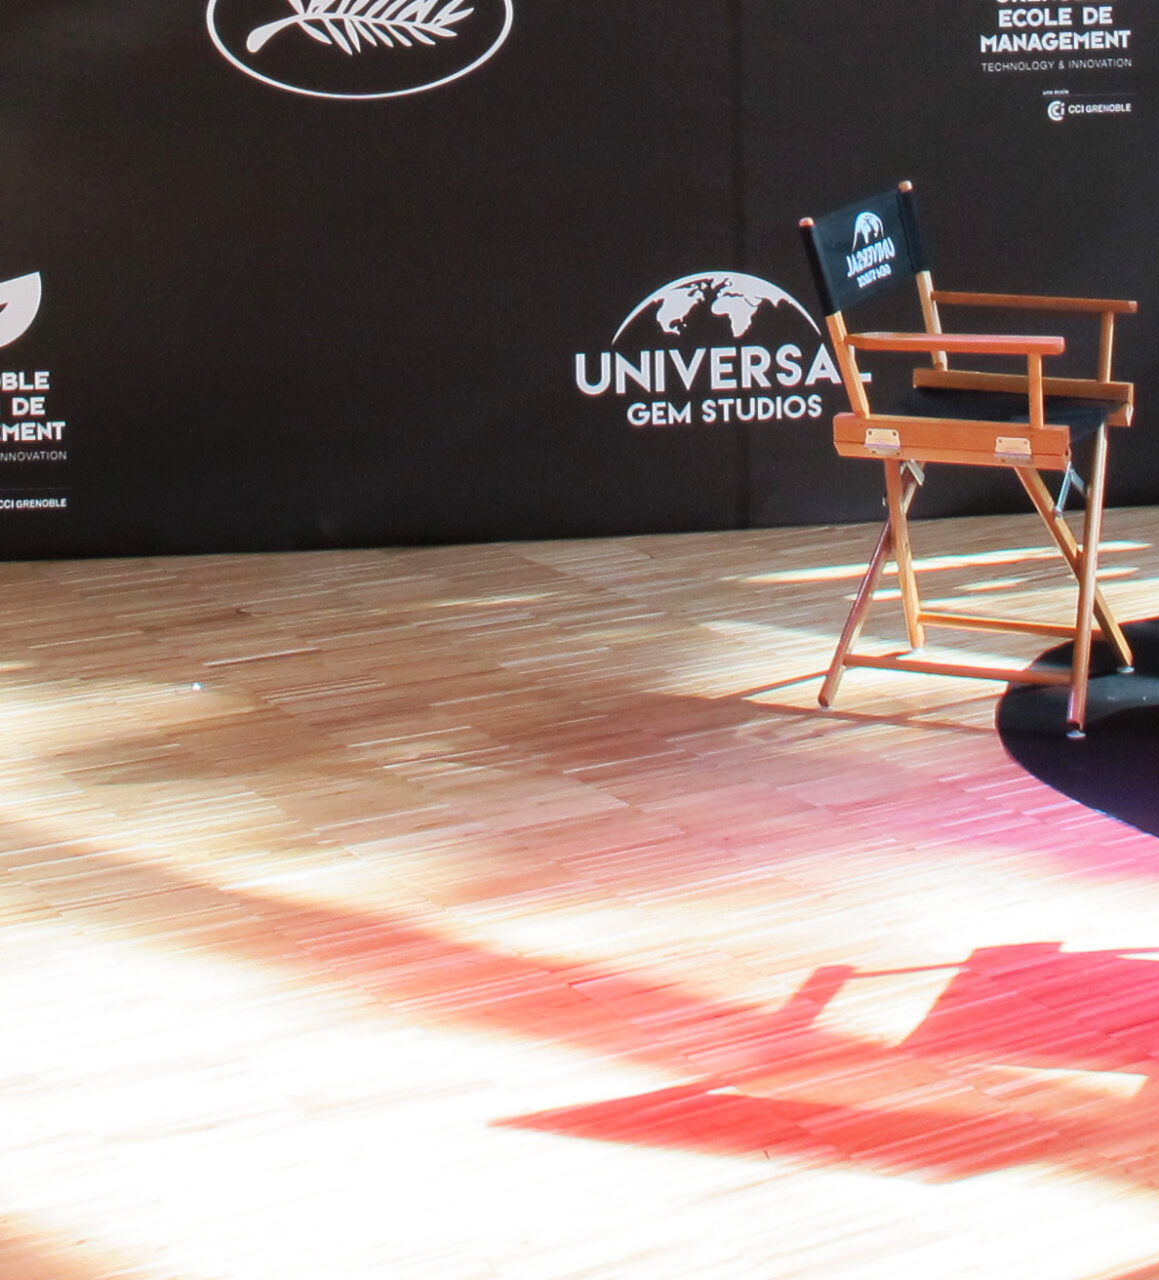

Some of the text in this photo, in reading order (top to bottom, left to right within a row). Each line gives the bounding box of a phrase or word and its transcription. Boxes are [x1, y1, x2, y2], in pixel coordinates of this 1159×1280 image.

[998, 6, 1113, 28] ECOLE DE
[980, 30, 1131, 53] MANAGEMENT
[981, 57, 1132, 72] TECHNOLOGY & INNOVATION
[1068, 103, 1132, 114] CCI GRENOBLE
[0, 371, 50, 391] BLE
[12, 396, 46, 416] DE
[627, 394, 823, 426] GEM STUDIOS
[0, 421, 66, 442] MENT
[16, 497, 67, 509] GRENOBLE
